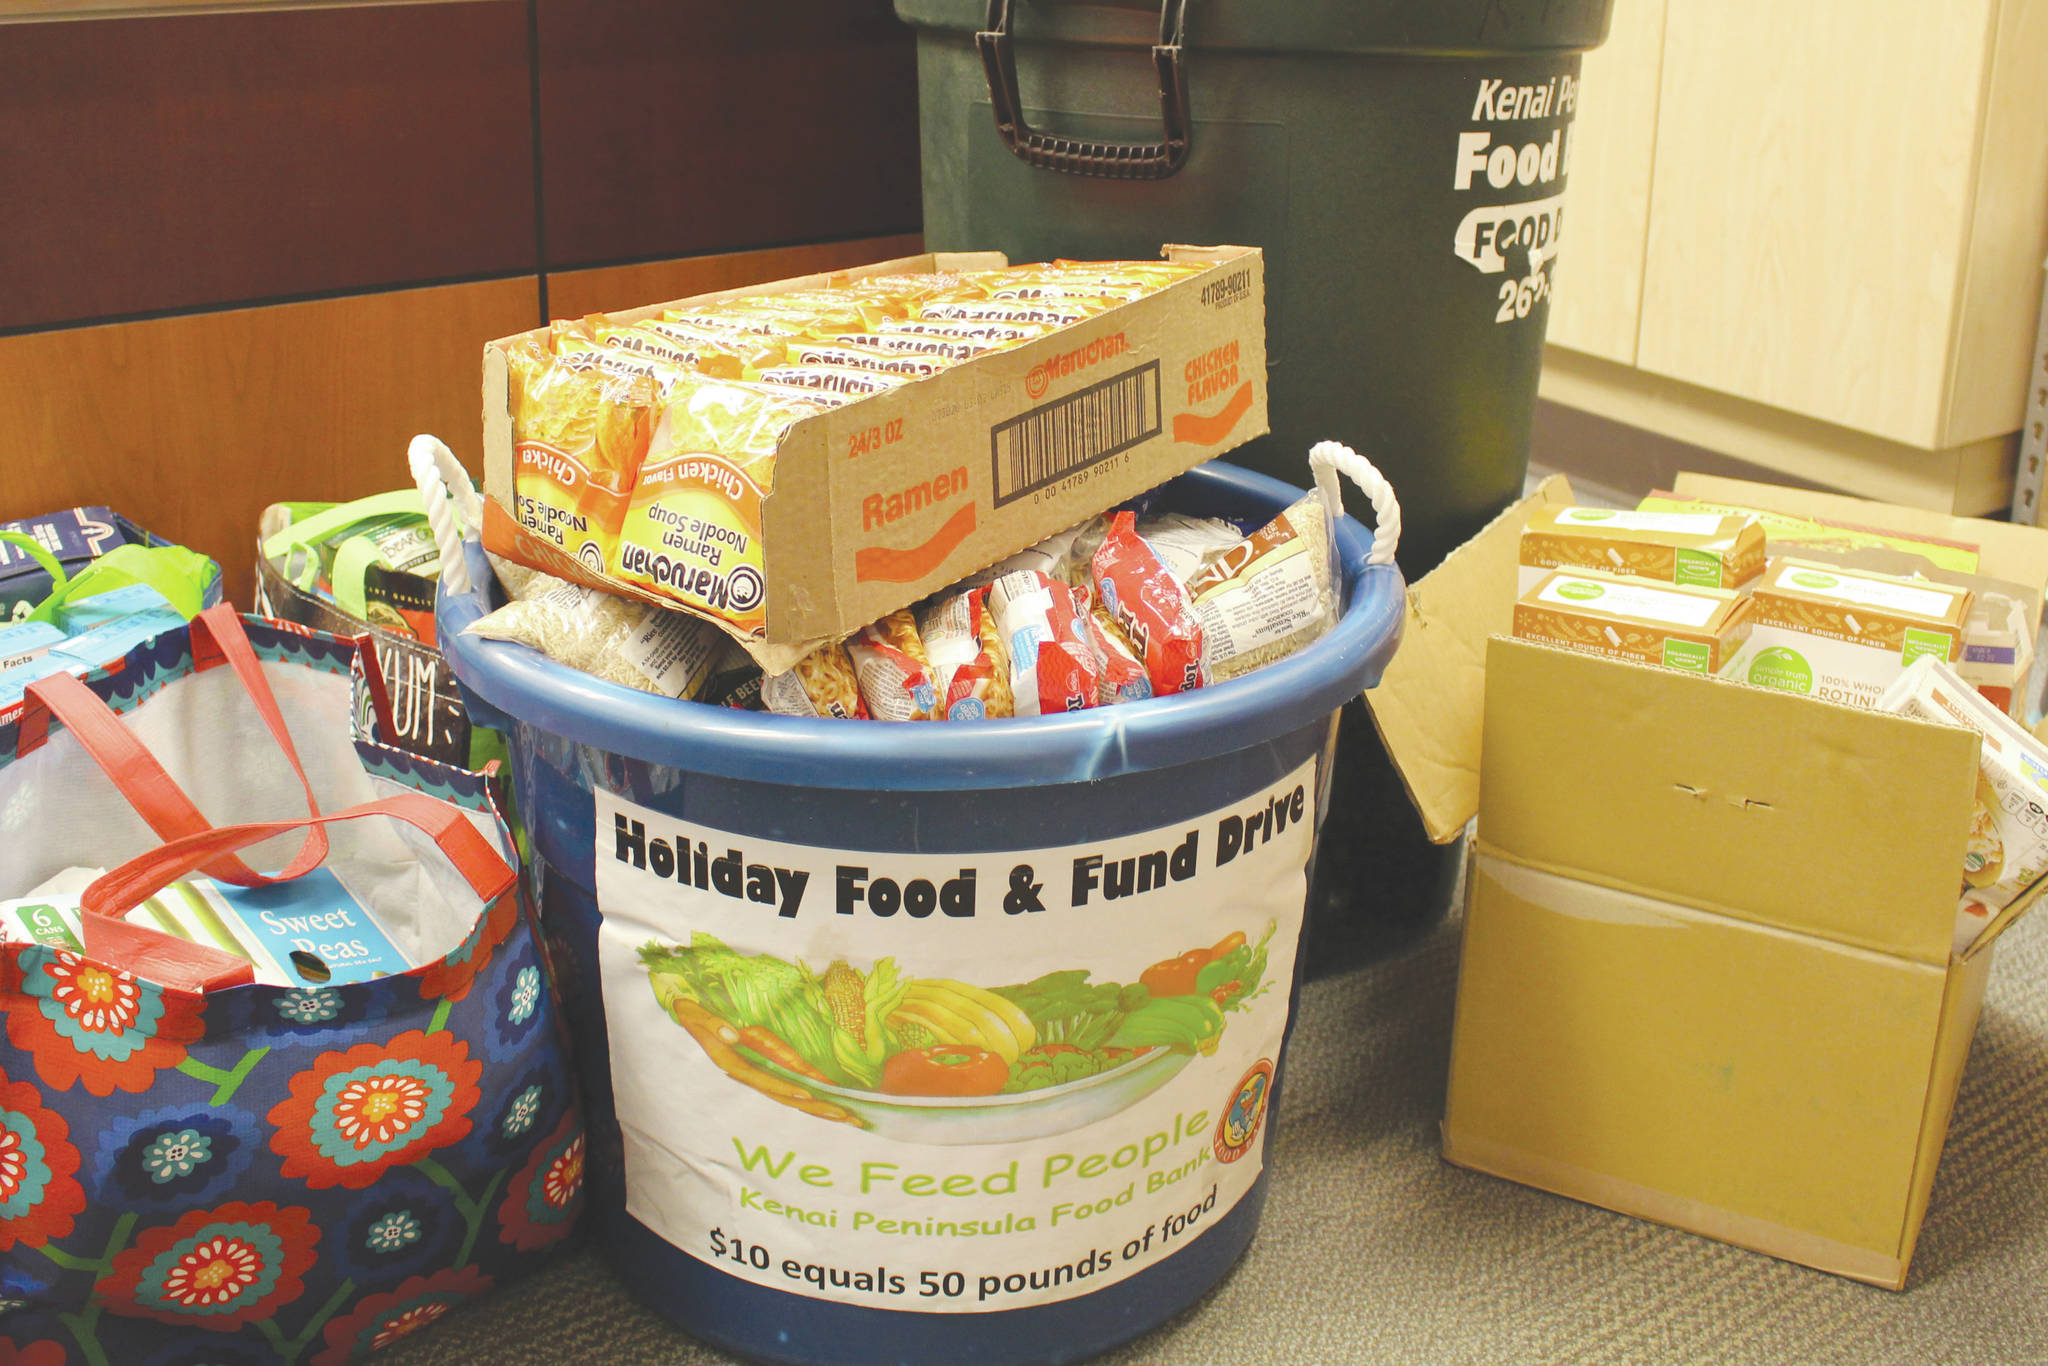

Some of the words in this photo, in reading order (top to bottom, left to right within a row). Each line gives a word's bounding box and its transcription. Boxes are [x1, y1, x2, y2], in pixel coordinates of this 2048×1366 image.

[1471, 77, 1556, 121] Kenai
[1454, 129, 1561, 190] Food
[1201, 268, 1250, 307] 41789-90211
[1045, 332, 1130, 381] Maruchan
[1185, 339, 1240, 383] CHICKEN
[1188, 364, 1239, 407] FLAVOR
[848, 427, 881, 459] 24/3
[642, 467, 675, 486] Flavor
[678, 460, 743, 500] Chicken
[1062, 471, 1088, 491] 41789
[1094, 458, 1119, 478] 90211
[1124, 453, 1129, 463] 6
[538, 502, 588, 532] Noodle
[649, 503, 689, 527] Soup
[863, 466, 968, 532] Ramen
[521, 510, 563, 545] Ramen
[690, 519, 748, 554] Noodle
[663, 531, 722, 567] Ramen
[622, 542, 729, 611] Maruchan
[1763, 618, 1809, 633] EXCELLENT
[1811, 628, 1844, 640] SOURCE
[1861, 638, 1886, 648] FIBER
[3, 656, 33, 669] Facts
[1785, 670, 1808, 681] truth
[1753, 673, 1808, 691] organic
[614, 812, 810, 919] Holiday
[836, 864, 977, 918] Food
[1003, 864, 1046, 915] &
[1071, 830, 1199, 908] Fund
[1216, 784, 1305, 868] Drive
[32, 908, 52, 927] 6
[259, 908, 357, 936] Sweet
[290, 938, 369, 961] Peas
[732, 1137, 834, 1188] We
[861, 1161, 1019, 1196] Feed
[1042, 1109, 1210, 1189] People
[740, 1186, 838, 1228] Kenai
[853, 1212, 1036, 1238] Peninsula
[1050, 1182, 1135, 1227] Food
[1146, 1145, 1211, 1194] Bank
[709, 1226, 770, 1271] $10
[781, 1258, 906, 1296] equals
[918, 1271, 965, 1297] 50
[978, 1249, 1112, 1301] pounds
[1121, 1224, 1155, 1261] of
[1161, 1183, 1218, 1243] food
